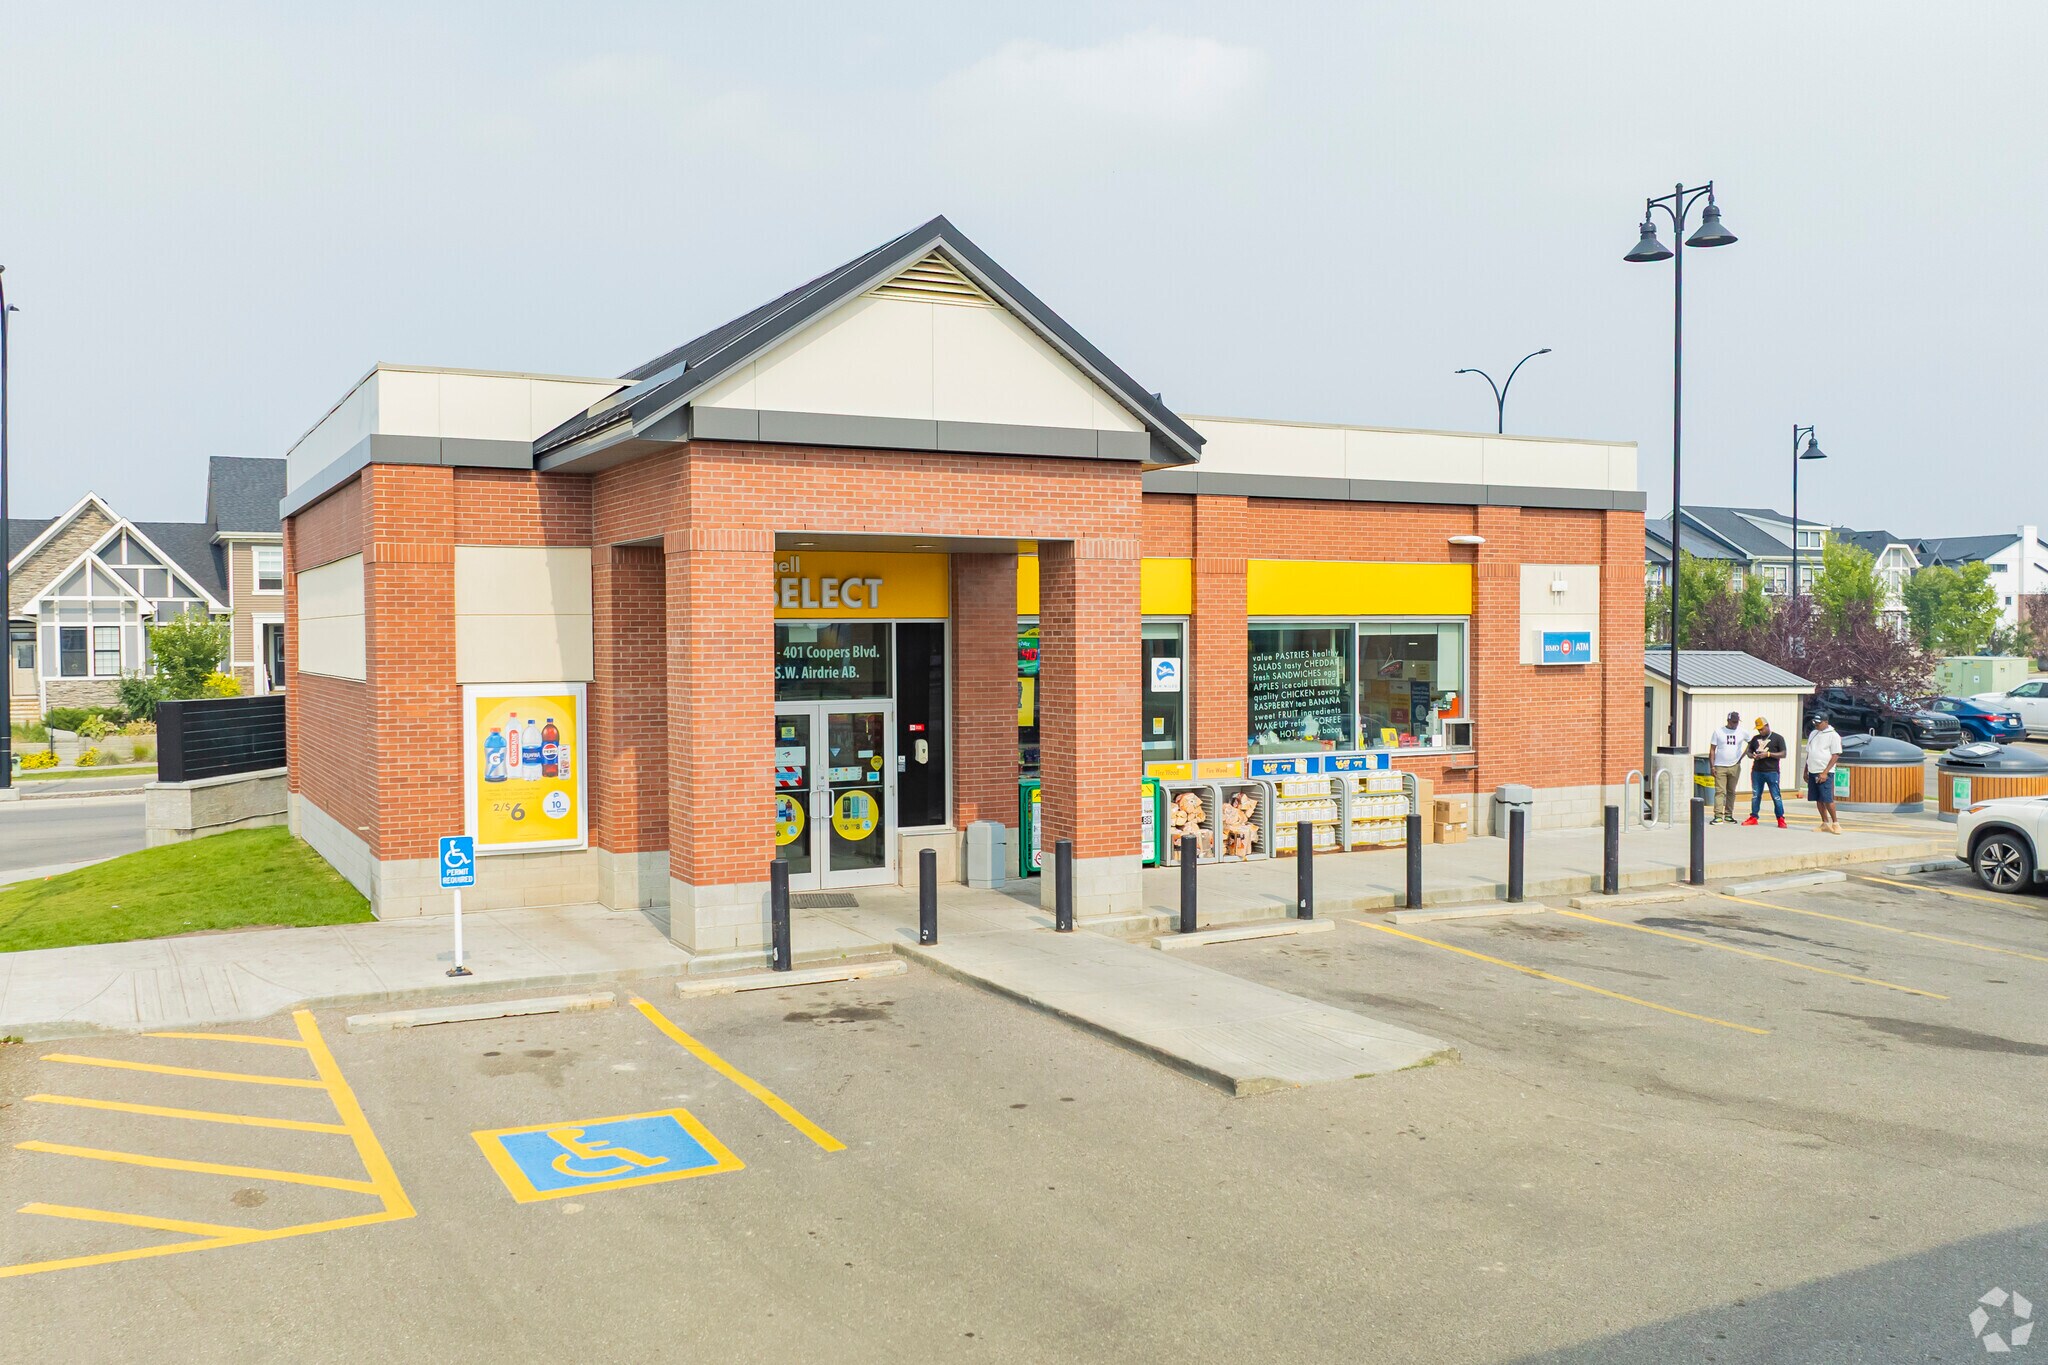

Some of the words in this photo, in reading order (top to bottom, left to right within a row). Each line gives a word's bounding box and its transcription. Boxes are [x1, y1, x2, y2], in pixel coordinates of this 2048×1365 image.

[1575, 642, 1589, 651] ATM
[783, 646, 803, 659] 401
[806, 646, 851, 661] Coopers
[852, 645, 880, 658] Blvd.
[1252, 653, 1273, 661] value
[1275, 650, 1310, 660] PASTRIES
[1312, 649, 1339, 659] healthy
[774, 666, 799, 679] S.W.
[801, 666, 839, 679] Airdrie
[841, 666, 860, 678] AB.
[1252, 662, 1282, 672] SALADS
[1253, 672, 1271, 682] fresh
[1272, 670, 1321, 680] SANDWICHES
[1253, 682, 1279, 691] APPLES
[1253, 692, 1279, 703] quality
[1281, 689, 1315, 699] CHICKEN
[1317, 688, 1341, 697] savory
[1254, 700, 1294, 711] RASPBERRY
[1308, 697, 1341, 706] BANANA
[1278, 710, 1299, 719] FRUIT
[1301, 707, 1341, 717] ingredients
[1314, 716, 1342, 725] COFFEE
[1280, 729, 1296, 738] HOT
[1322, 726, 1342, 734] bacon
[552, 800, 562, 809] 10
[446, 868, 469, 877] PERMIT
[442, 876, 473, 885] REQUIRED
